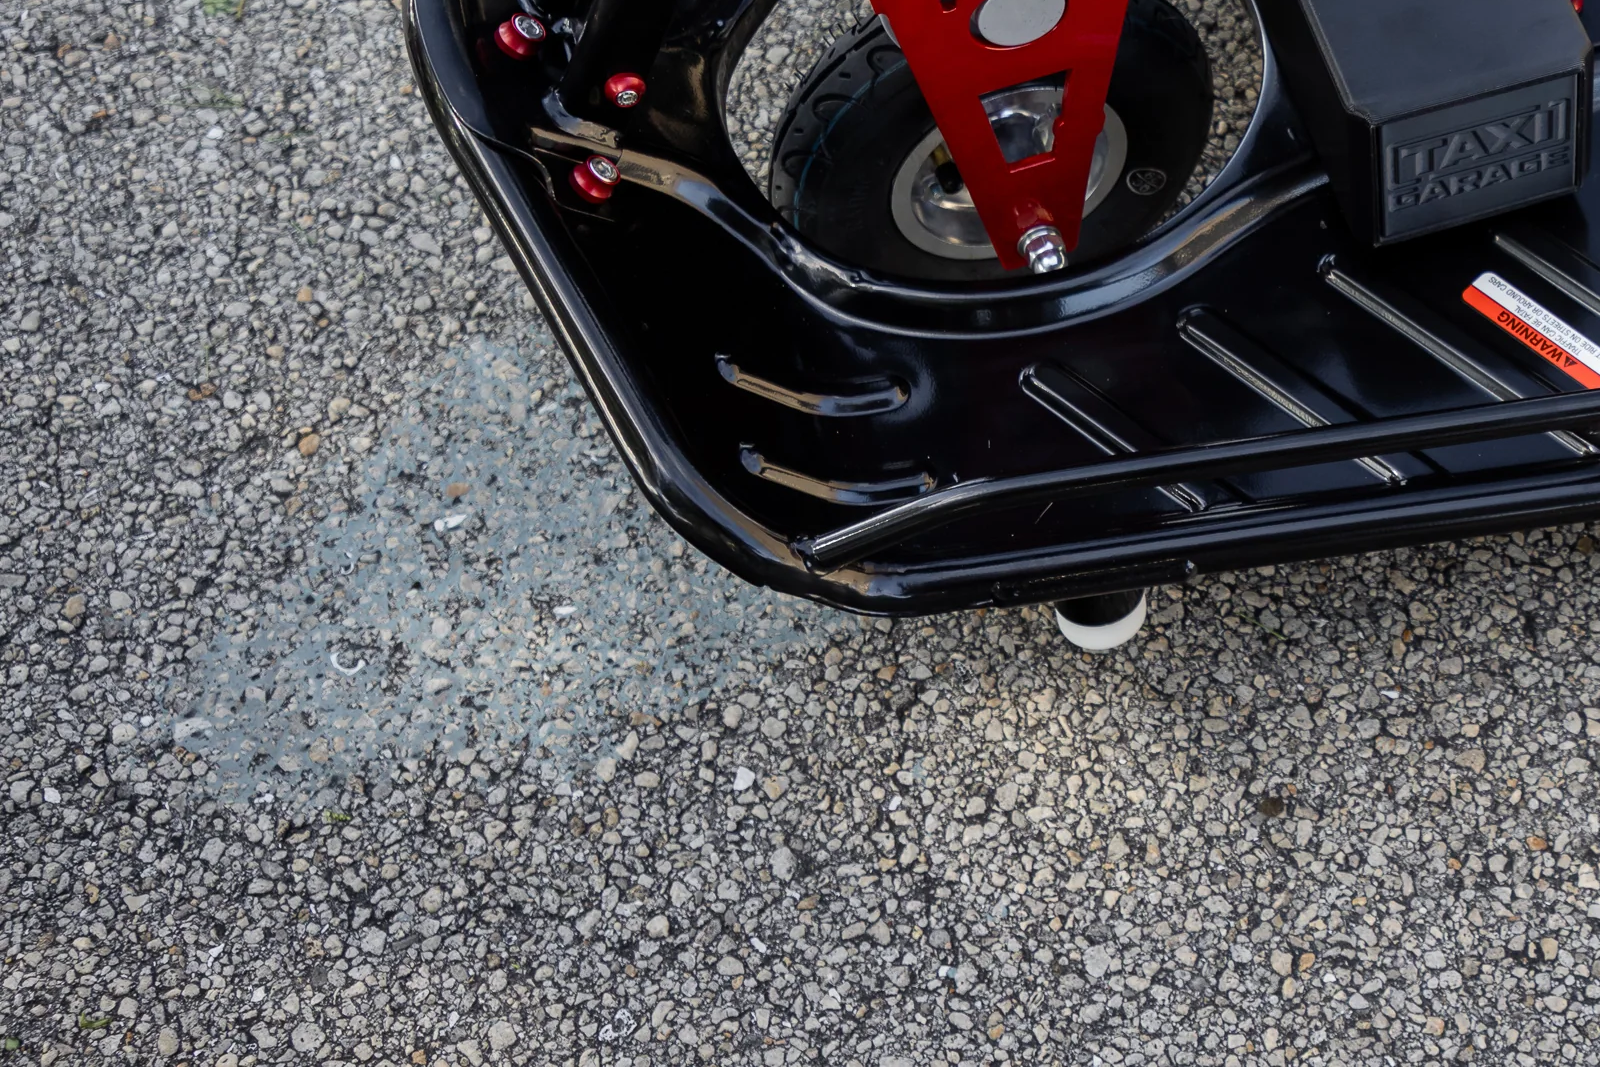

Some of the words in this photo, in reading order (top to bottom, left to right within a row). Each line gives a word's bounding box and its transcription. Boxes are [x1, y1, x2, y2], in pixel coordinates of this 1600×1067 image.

[1401, 111, 1553, 176] TAXI
[1388, 146, 1571, 213] GARAGE
[1488, 275, 1507, 291] CARS
[1506, 289, 1534, 309] AROUND
[1514, 304, 1533, 321] FATAL
[1531, 307, 1543, 316] OR
[1531, 318, 1542, 327] BE
[1541, 324, 1556, 337] CAN
[1542, 313, 1571, 336] STREETS
[1497, 310, 1563, 362] WARNING
[1569, 333, 1581, 343] ON
[1554, 335, 1581, 356] TRAFFIC
[1580, 341, 1597, 354] RIDE
